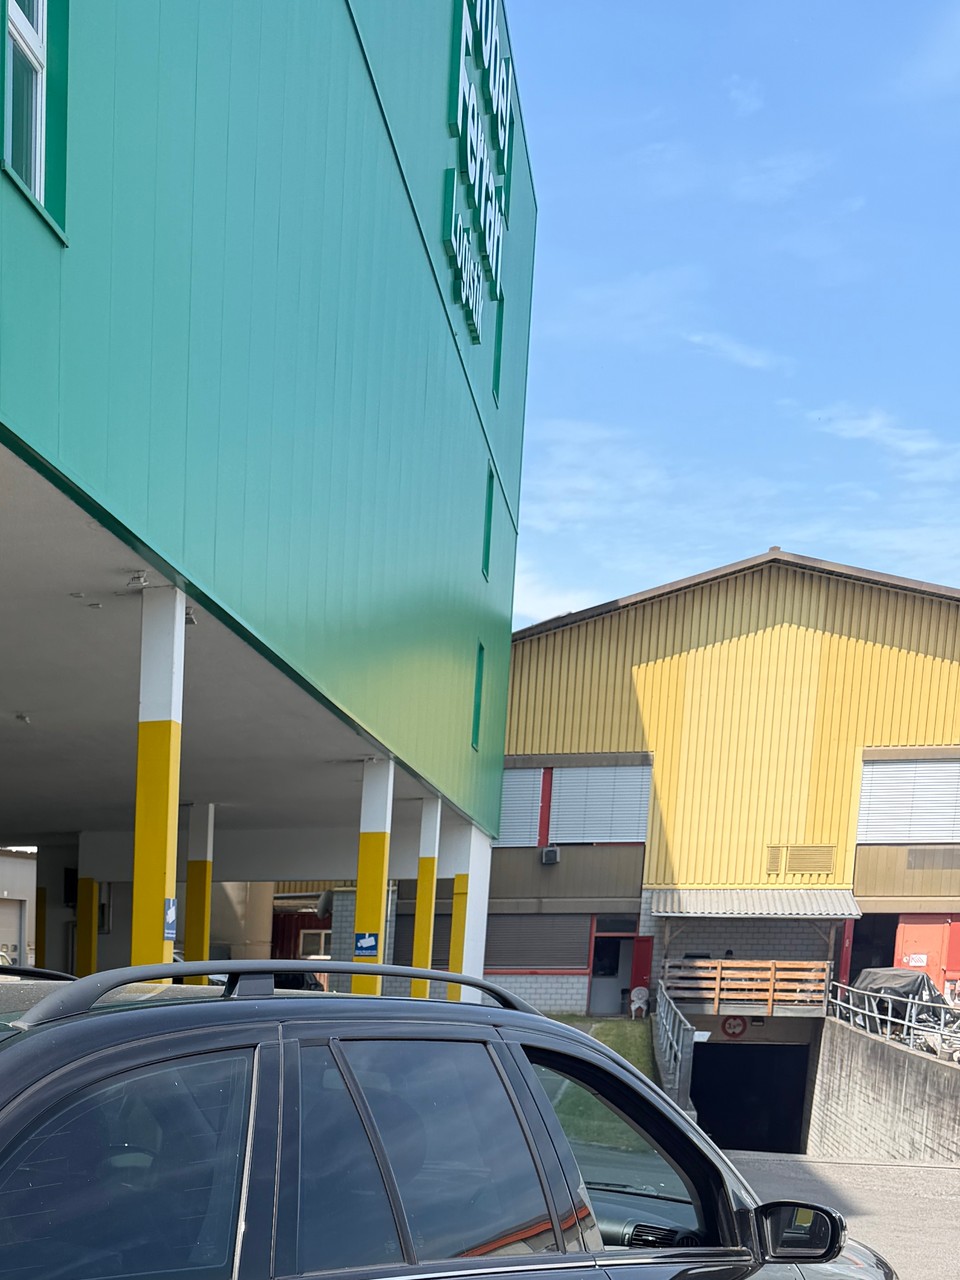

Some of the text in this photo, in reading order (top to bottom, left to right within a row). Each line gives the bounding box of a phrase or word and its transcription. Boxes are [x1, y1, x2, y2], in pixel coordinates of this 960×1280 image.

[457, 0, 505, 299] Ferrari
[473, 0, 512, 173] bel
[451, 169, 484, 344] Logistik
